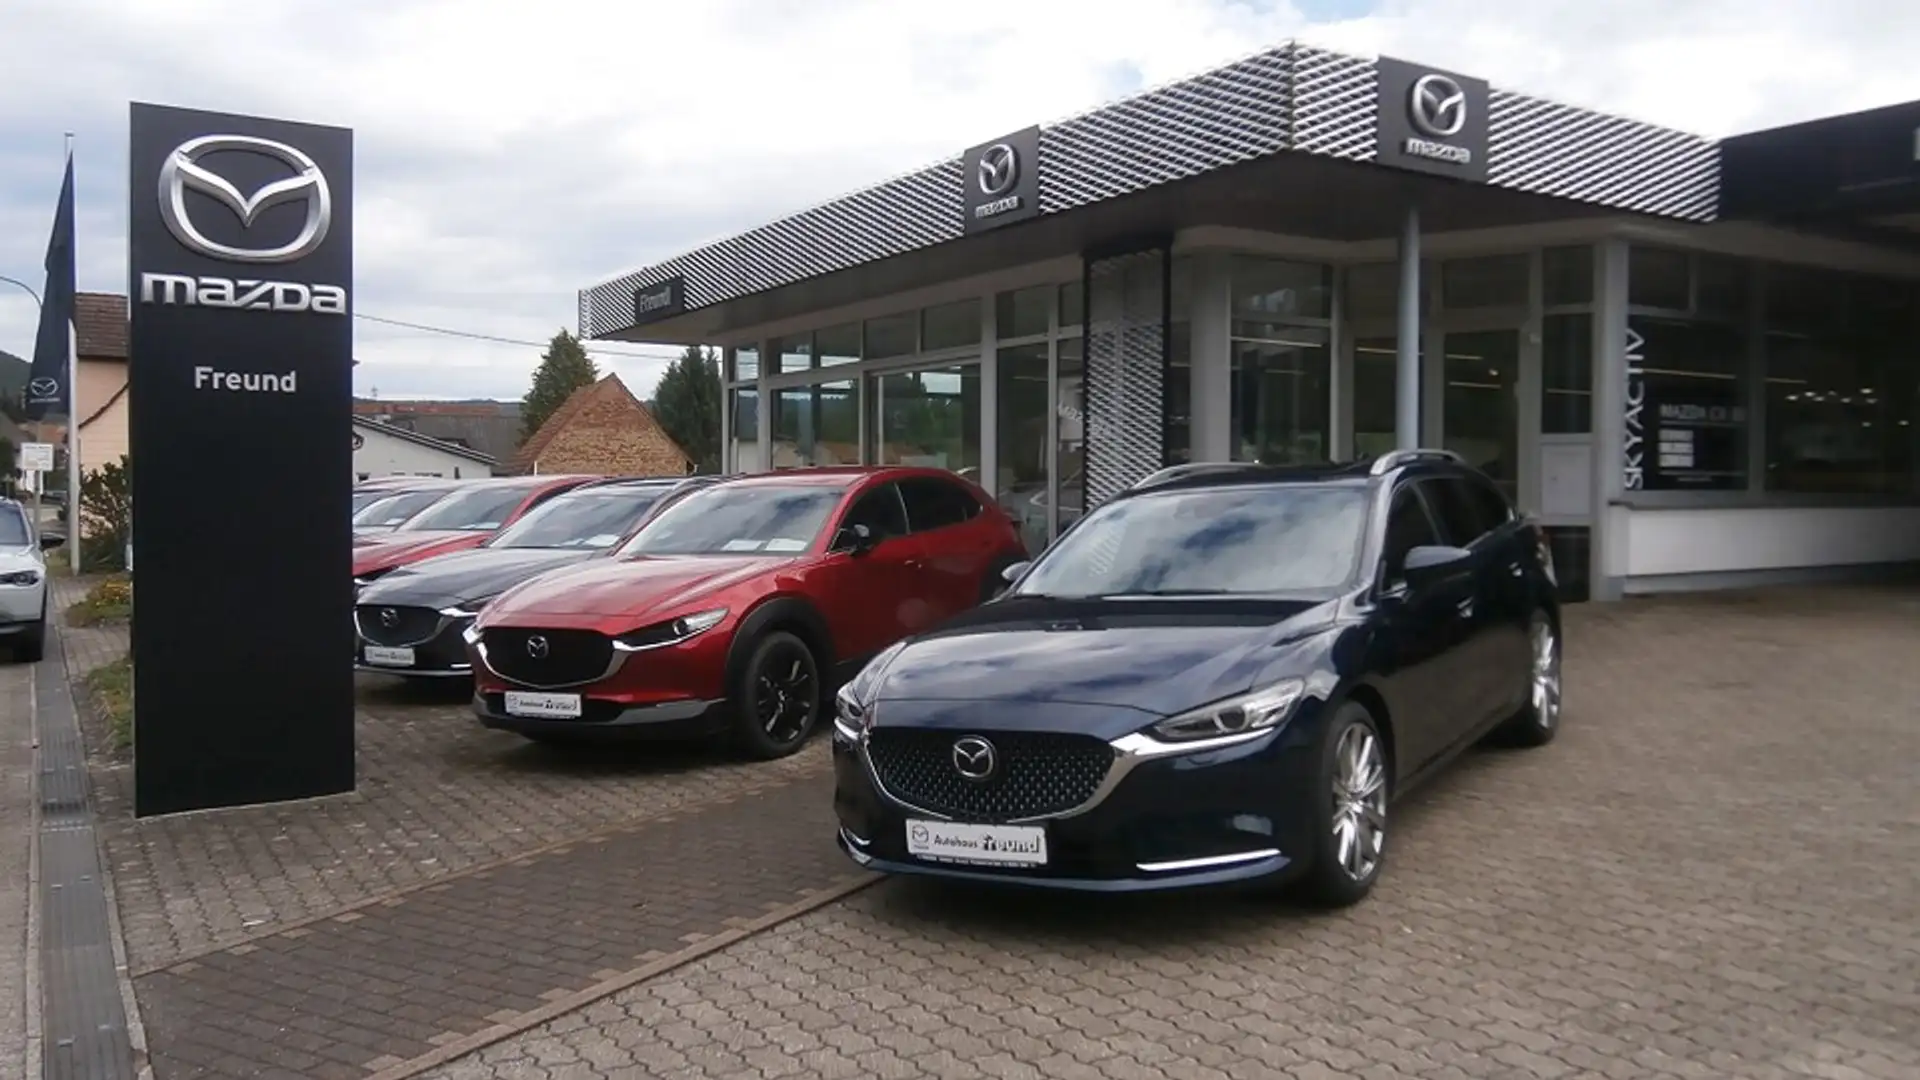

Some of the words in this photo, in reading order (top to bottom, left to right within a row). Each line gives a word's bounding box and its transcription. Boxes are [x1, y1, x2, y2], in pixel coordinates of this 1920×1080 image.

[194, 366, 296, 392] Freund
[1624, 328, 1645, 490] SKYACTIV
[933, 833, 979, 849] Autohaus
